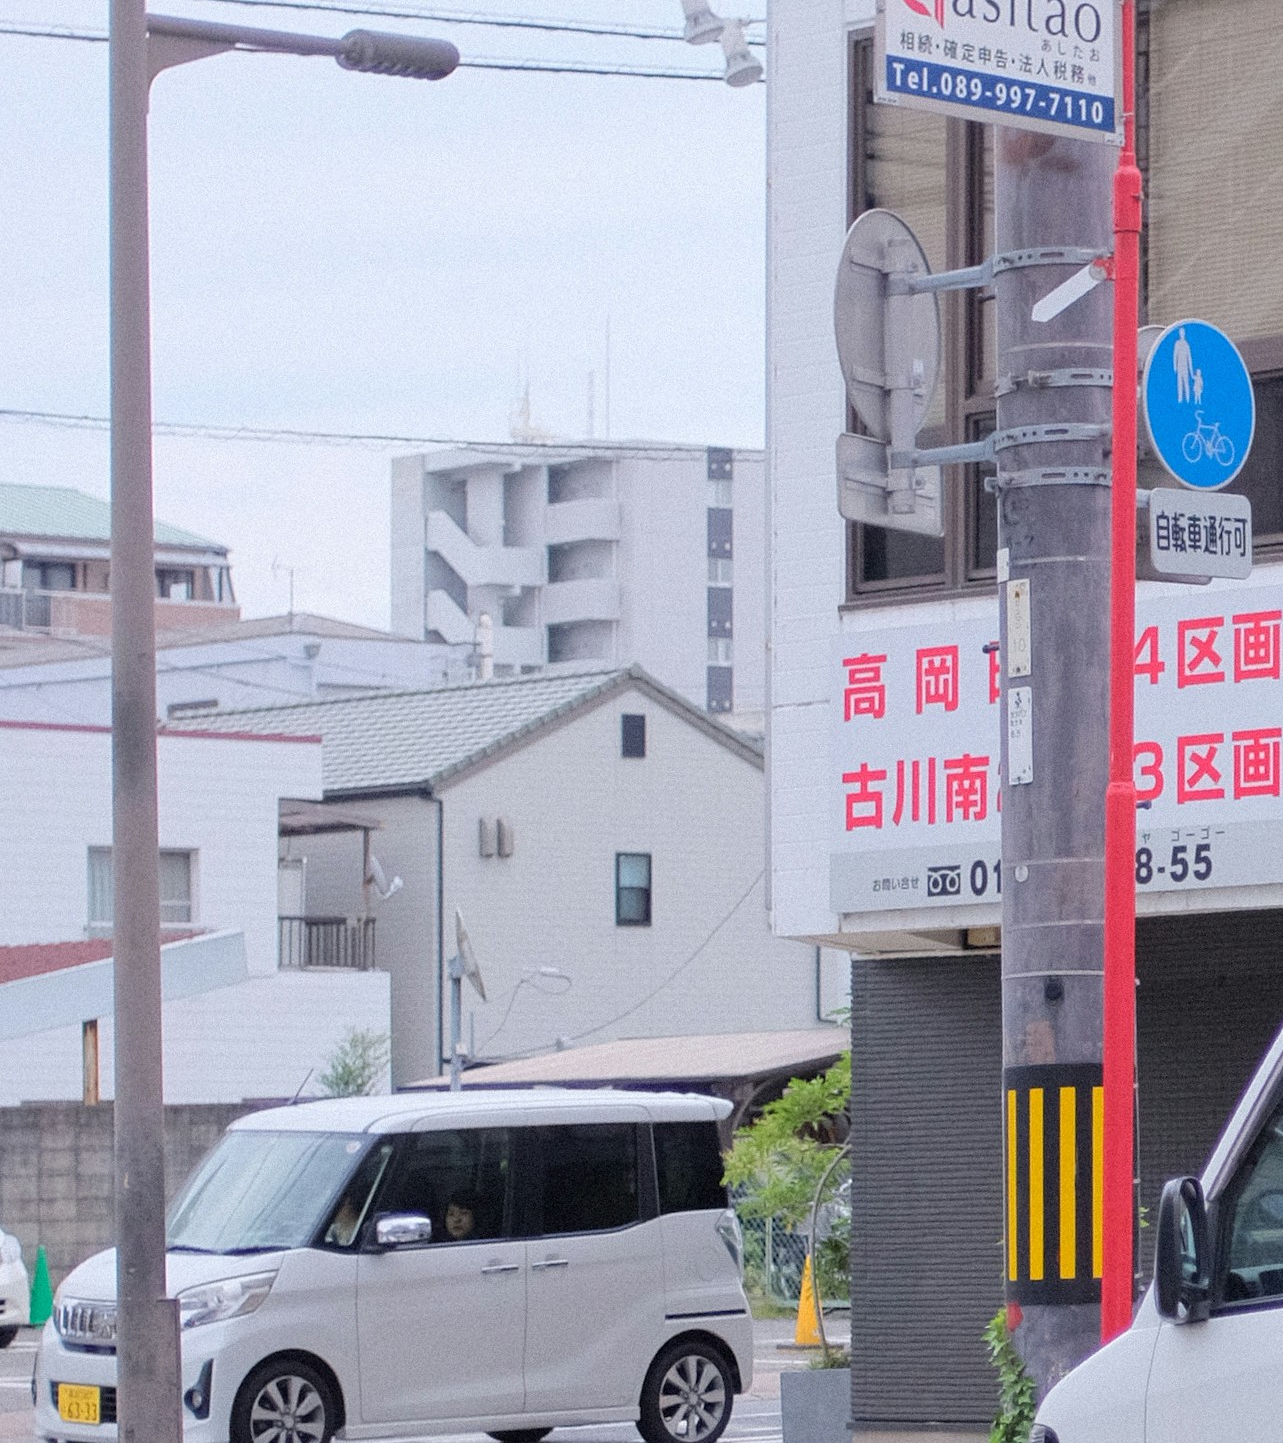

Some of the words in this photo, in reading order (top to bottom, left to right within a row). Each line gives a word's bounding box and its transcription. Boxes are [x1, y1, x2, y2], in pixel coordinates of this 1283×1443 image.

[1041, 39, 1100, 62] あしたお
[1156, 510, 1248, 557] 自転車通行可
[1134, 610, 1283, 689] 4区画
[842, 754, 1001, 832] 古川南
[1134, 727, 1283, 804] 3区画
